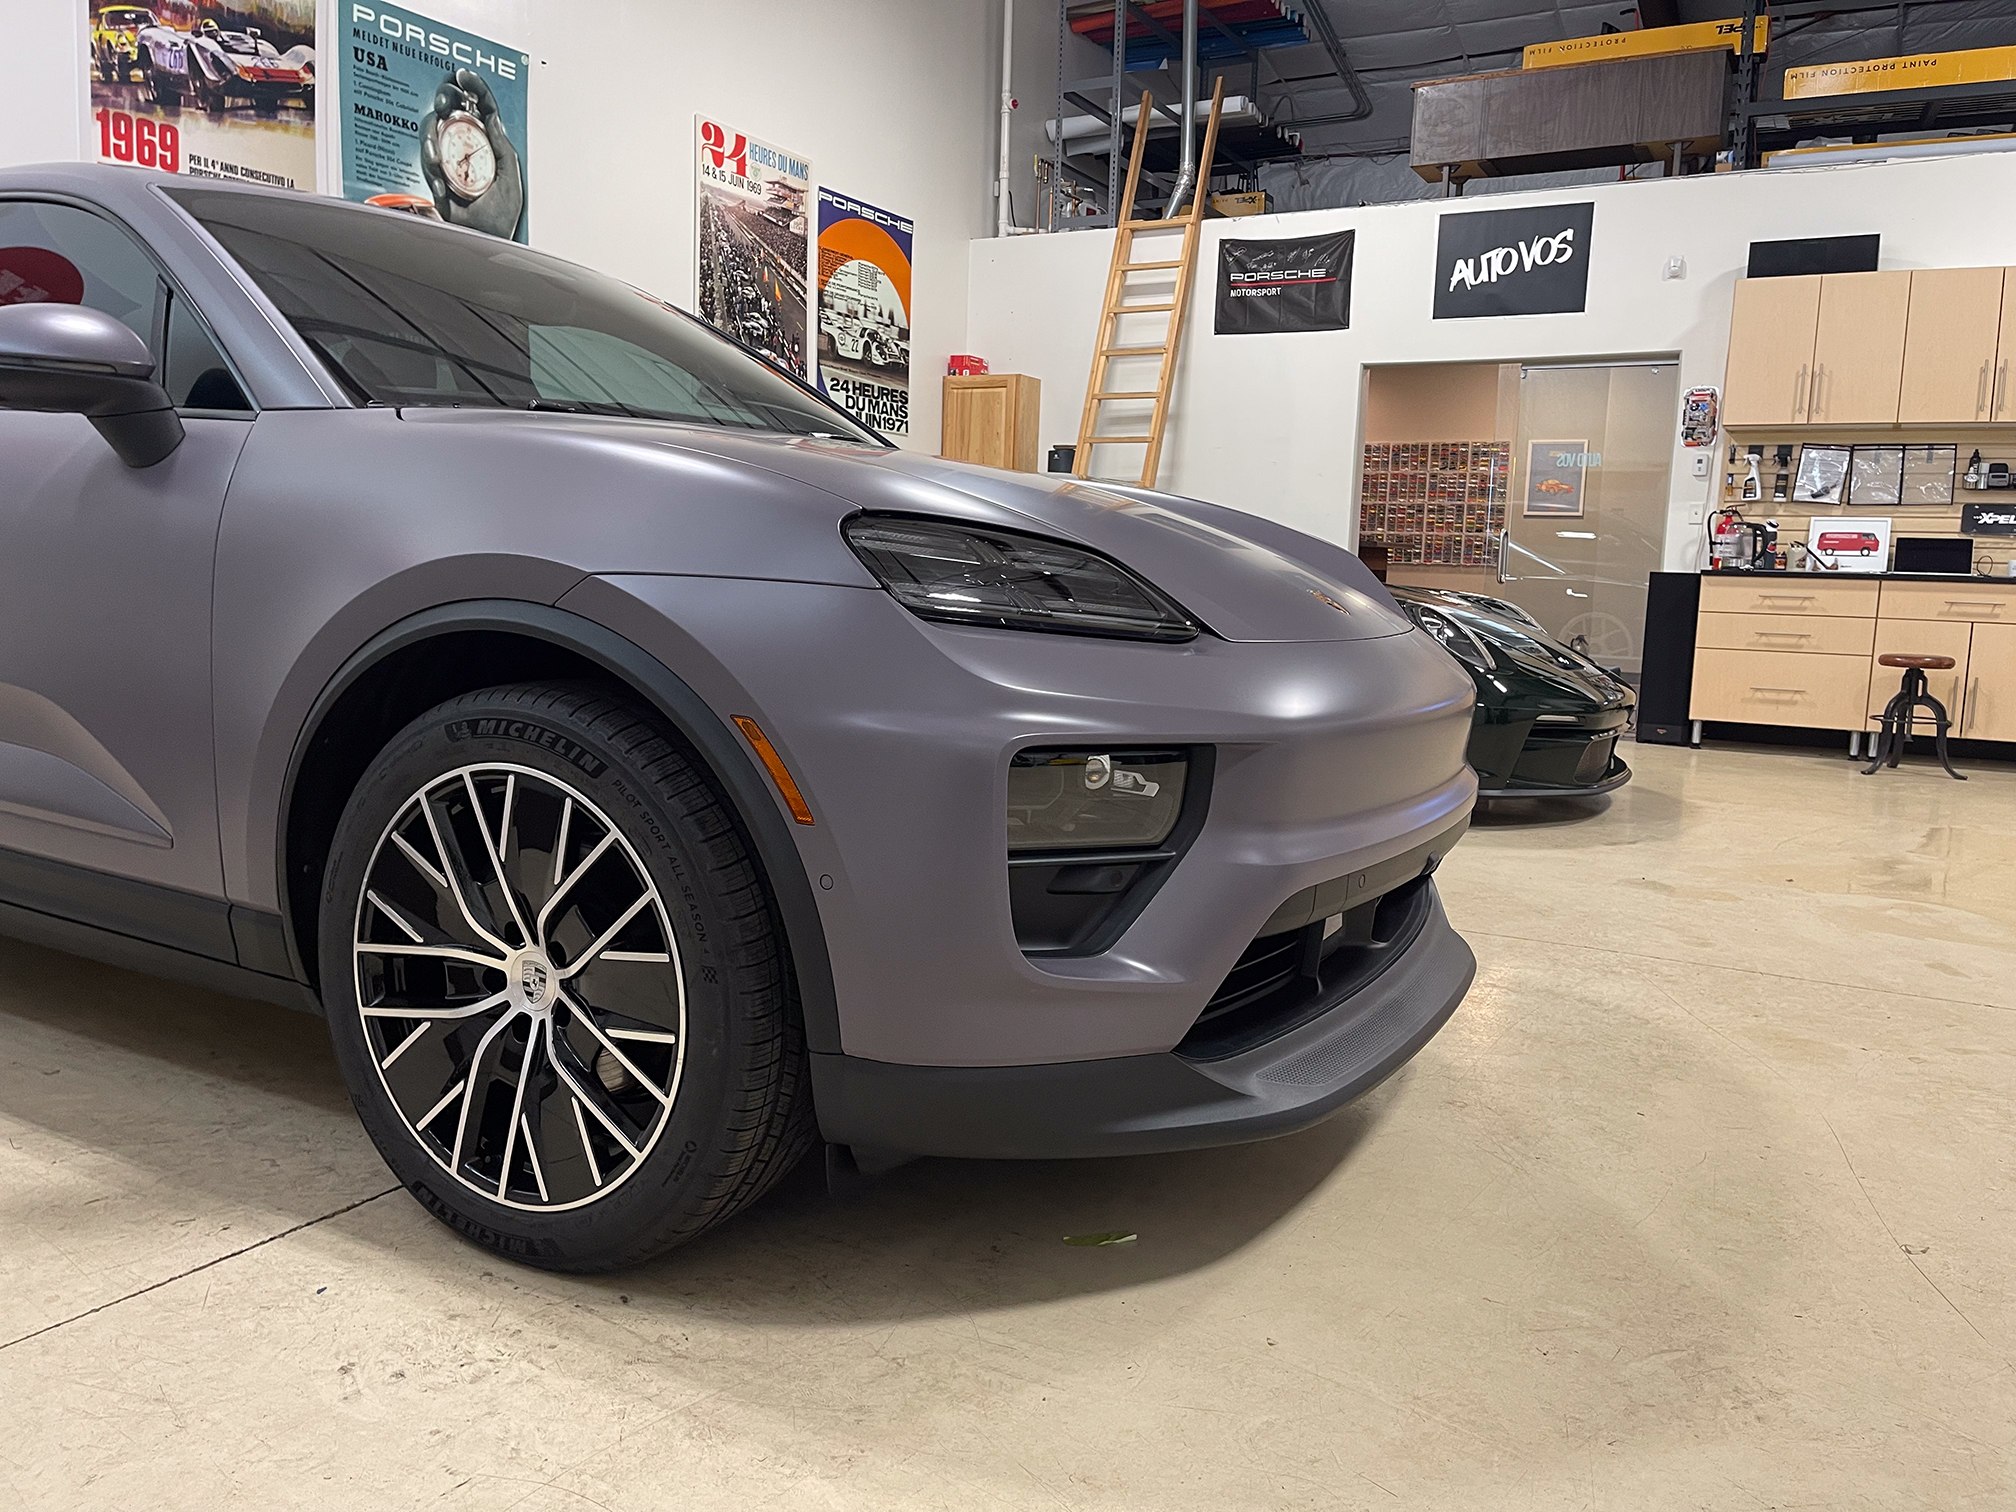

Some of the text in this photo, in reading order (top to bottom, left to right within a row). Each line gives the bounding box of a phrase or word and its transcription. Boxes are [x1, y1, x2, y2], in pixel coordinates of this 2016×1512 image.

[352, 3, 517, 81] PORSCHE
[352, 27, 389, 49] MELDET
[392, 41, 416, 59] NEUE
[352, 45, 388, 71] USA
[1528, 37, 1627, 56] PROTECTION FILM
[1790, 59, 1937, 80] PAINT PROTECTION FILM
[354, 103, 419, 132] MAROKKO
[96, 107, 180, 174] 1969
[701, 121, 809, 181] 24 HEURES DU MANS
[189, 153, 202, 166] PER
[220, 162, 239, 175] ANNO
[240, 166, 286, 187] CONSECUTIVO
[702, 164, 762, 196] 14 & 15 JUIN 1969
[818, 190, 913, 235] PORSCHE
[1230, 268, 1327, 282] PORSCHE
[1448, 227, 1575, 293] AUTO VOS
[1230, 287, 1282, 298] MOTORSPORT
[829, 377, 909, 405] 24 HEURES
[845, 394, 909, 419] DU MANS
[882, 416, 909, 434] 1971
[476, 719, 601, 773] MICHELIN
[612, 779, 708, 943] PILOT SPORT ALL SEASON
